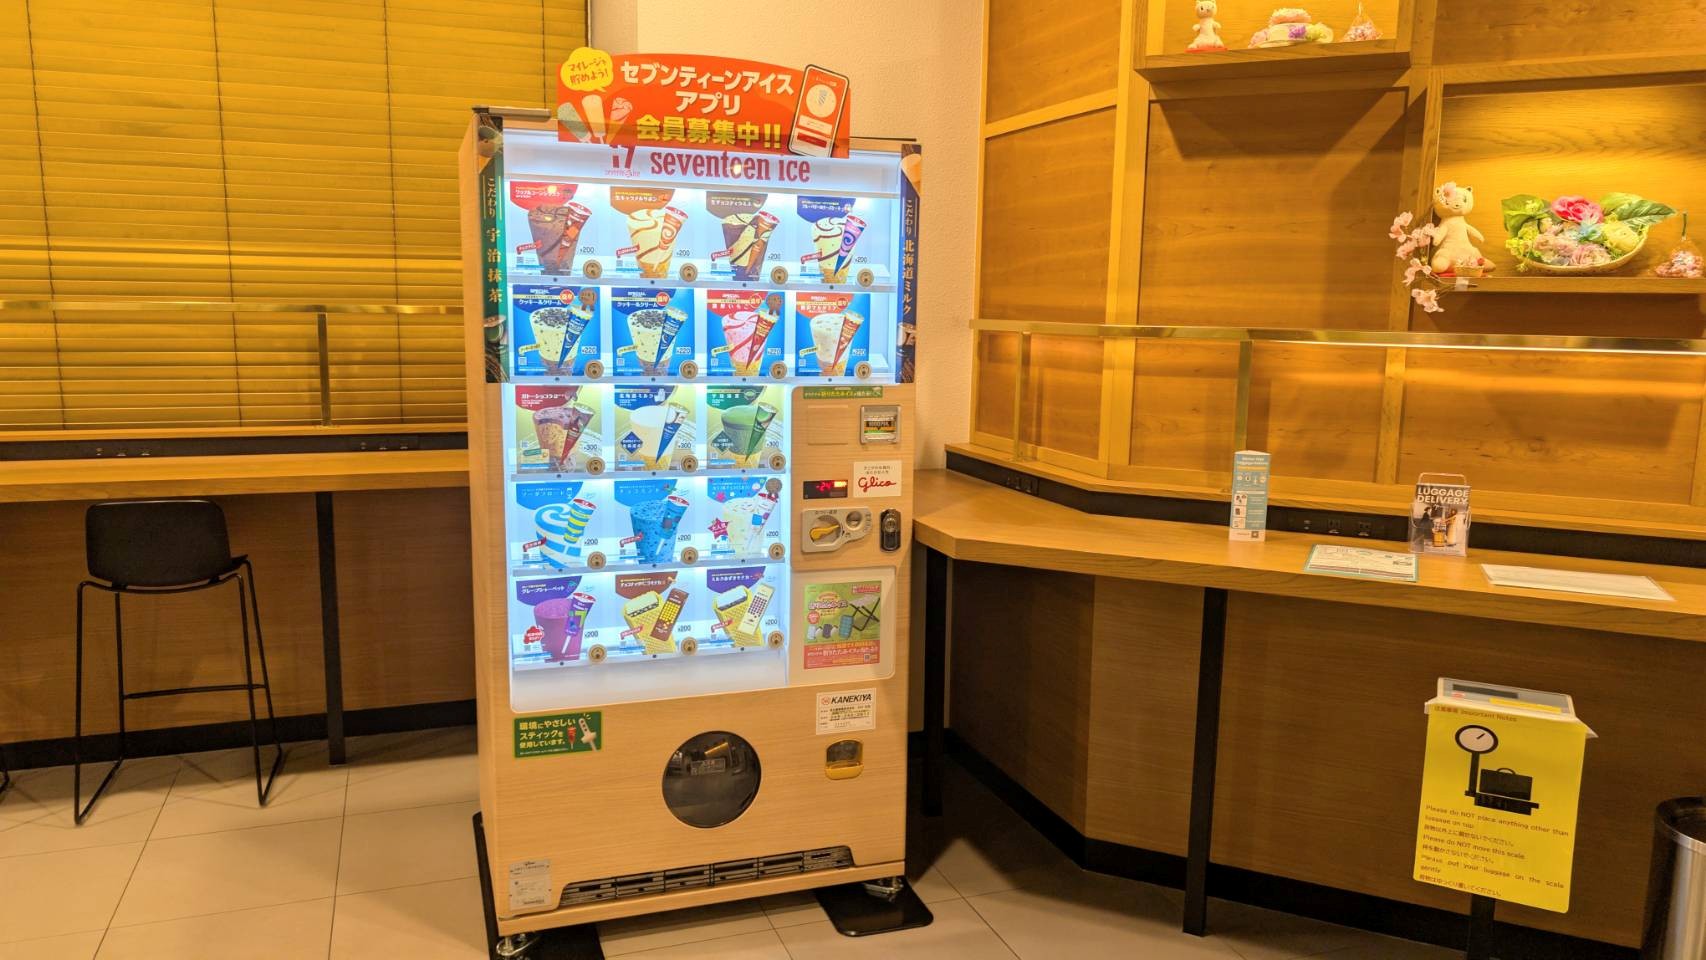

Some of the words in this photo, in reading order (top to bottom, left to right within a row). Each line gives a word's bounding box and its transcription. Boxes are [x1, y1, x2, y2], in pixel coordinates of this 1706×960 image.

[620, 60, 794, 96] セブンティーンアイス
[675, 90, 741, 116] アプリ
[650, 151, 771, 180] seventeen
[778, 156, 811, 182] ice
[487, 178, 496, 218] こだわり
[486, 228, 502, 303] 宇治抹茶
[902, 239, 915, 316] 北海道ミルク
[858, 476, 896, 492] Glico
[1418, 487, 1468, 498] LUGGAGE
[1417, 495, 1468, 505] DELIVERY
[831, 694, 872, 704] KANEKIYA
[520, 719, 576, 730] 環境にやさしい
[520, 730, 564, 740] スティックを
[520, 739, 565, 748] 使用しています。
[1426, 804, 1447, 813] Please
[1478, 815, 1496, 824] place
[1499, 819, 1528, 830] anything
[1530, 824, 1550, 833] other
[1552, 828, 1569, 836] than
[1424, 834, 1444, 844] Please
[1448, 860, 1460, 868] put
[1464, 864, 1479, 872] your
